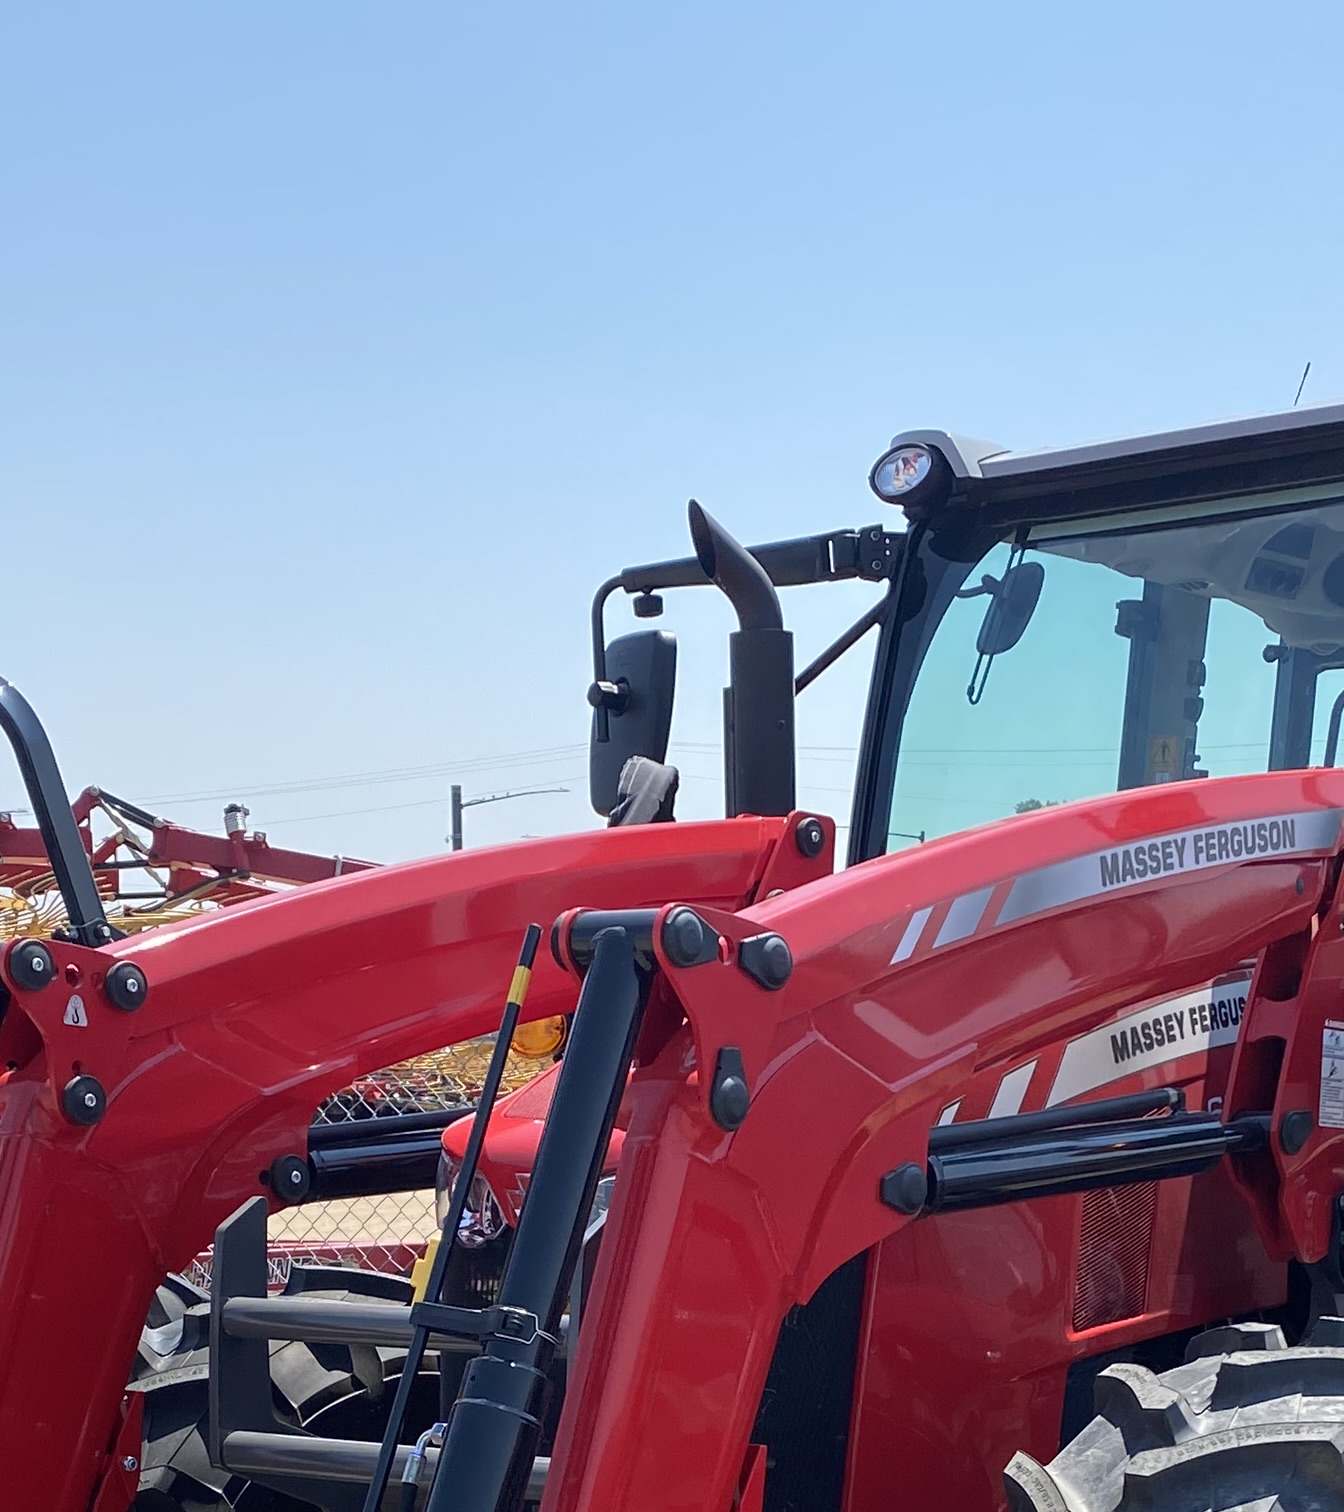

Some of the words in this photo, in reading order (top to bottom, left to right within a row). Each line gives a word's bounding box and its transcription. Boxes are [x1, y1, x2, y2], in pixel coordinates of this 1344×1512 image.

[1099, 837, 1187, 888] MASSEY
[1193, 818, 1296, 865] FERGUSON
[1110, 1010, 1185, 1065] MASSEY
[1189, 996, 1247, 1037] FERGUS
